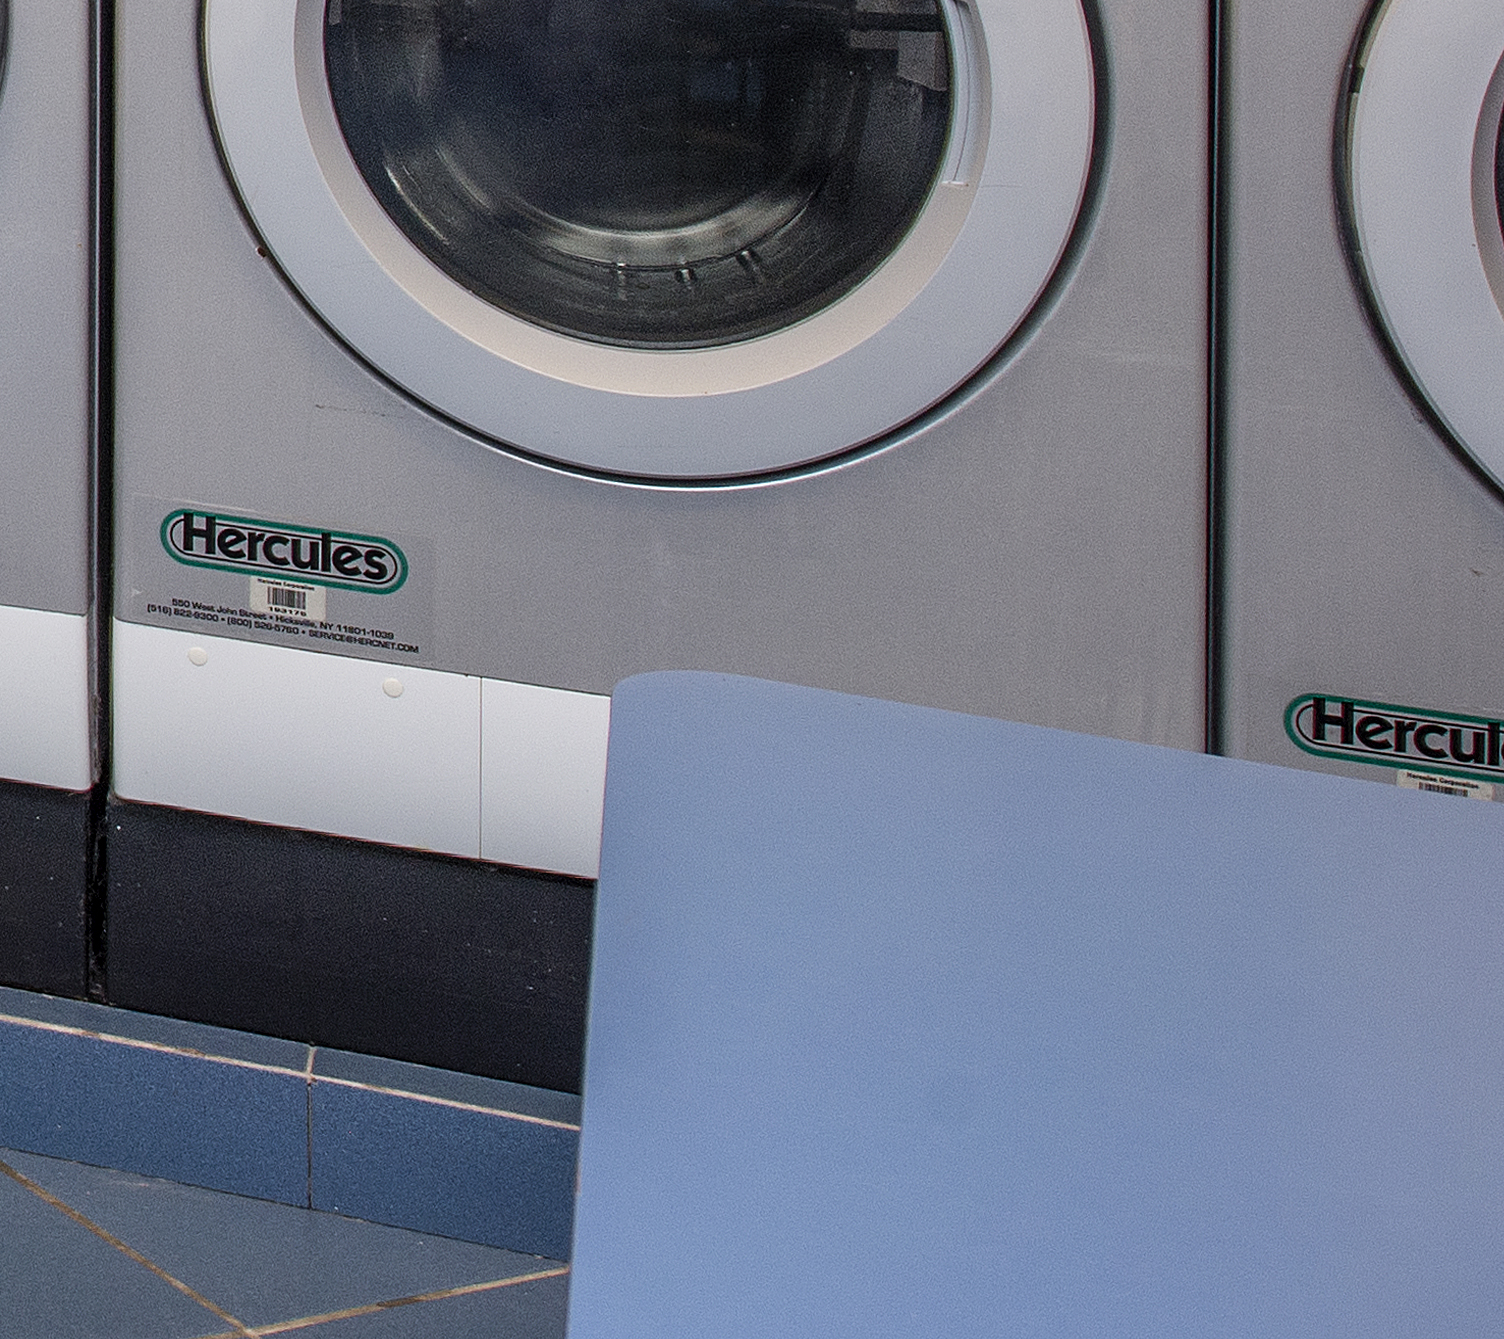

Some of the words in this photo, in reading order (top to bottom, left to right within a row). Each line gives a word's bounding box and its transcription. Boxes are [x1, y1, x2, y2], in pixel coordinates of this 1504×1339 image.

[182, 512, 388, 580] Hercules
[1313, 696, 1504, 766] Hercul
[1406, 772, 1438, 784] Hercules
[1439, 777, 1480, 790] Corporation
